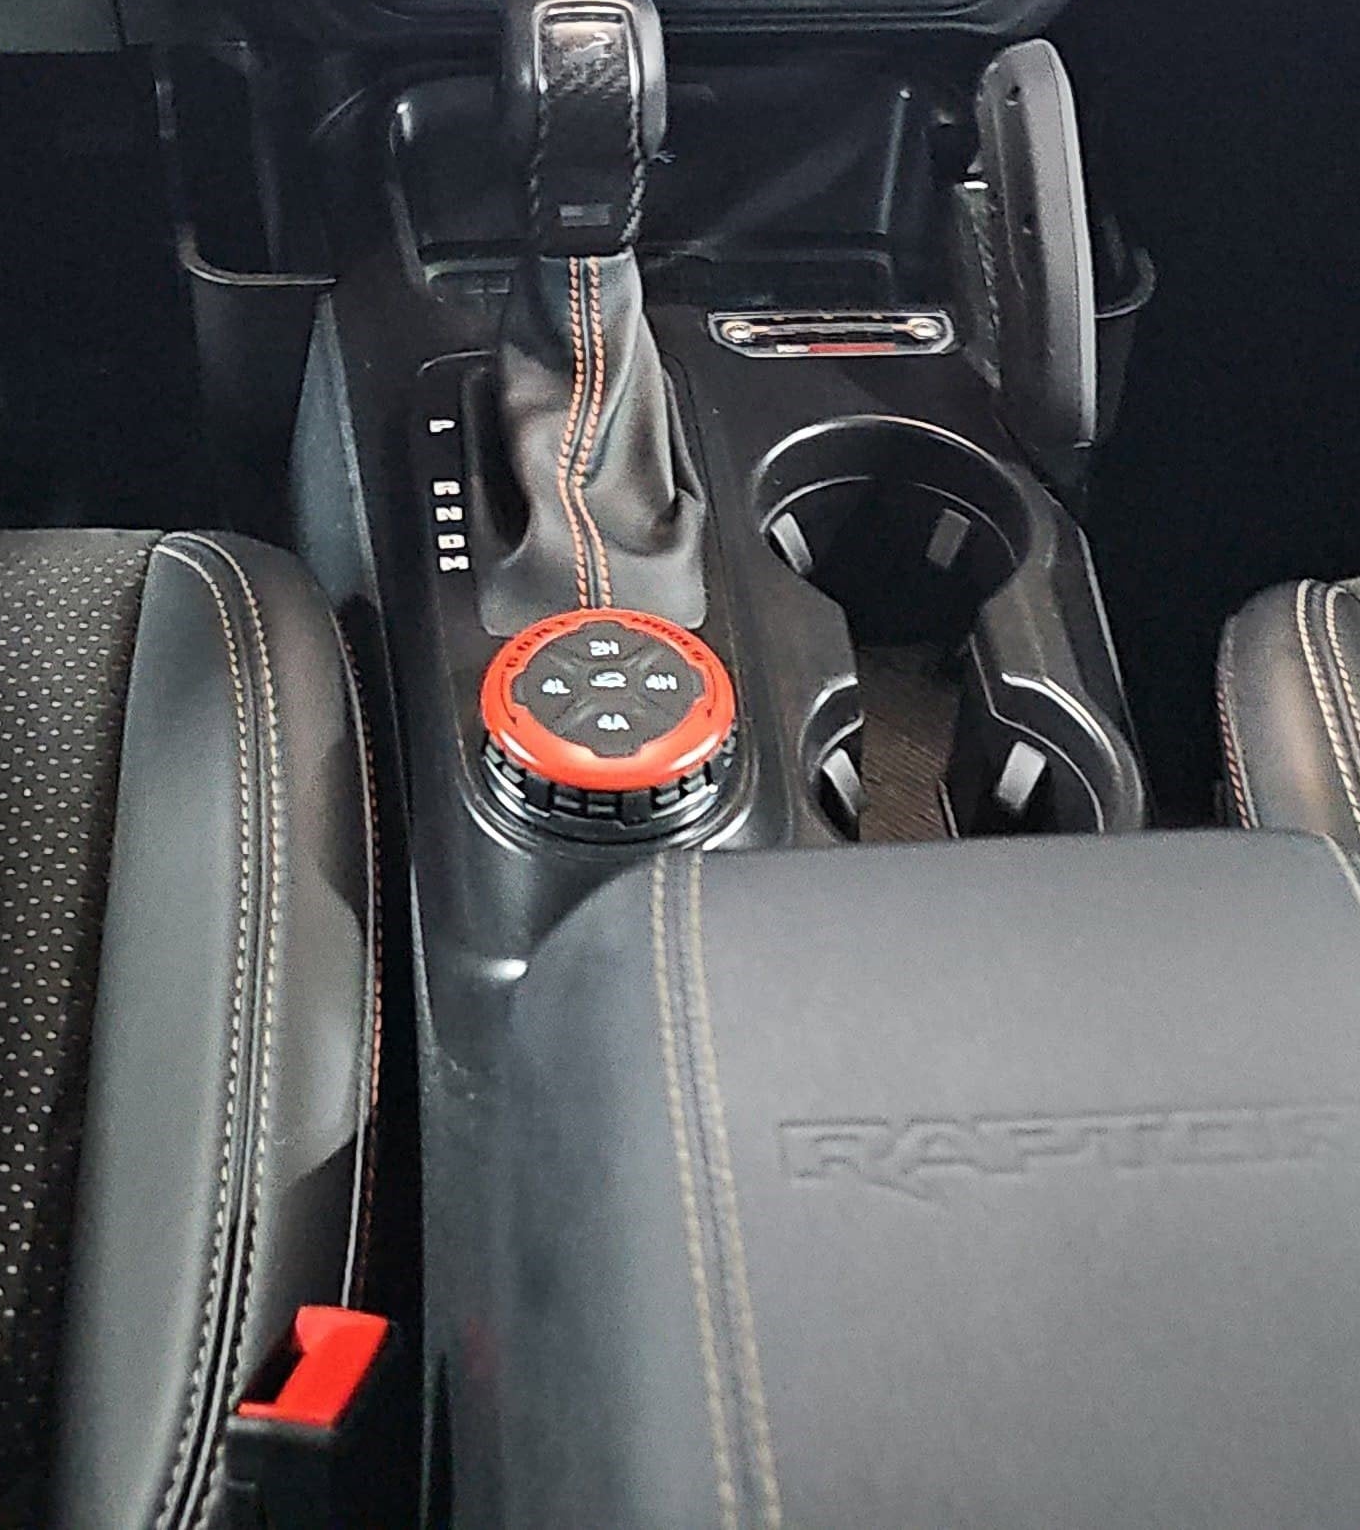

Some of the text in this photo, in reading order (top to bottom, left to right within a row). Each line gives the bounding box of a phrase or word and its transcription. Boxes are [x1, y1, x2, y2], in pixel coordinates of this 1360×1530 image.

[432, 481, 461, 496] R
[435, 506, 463, 521] N
[438, 534, 465, 549] D
[439, 556, 469, 571] M
